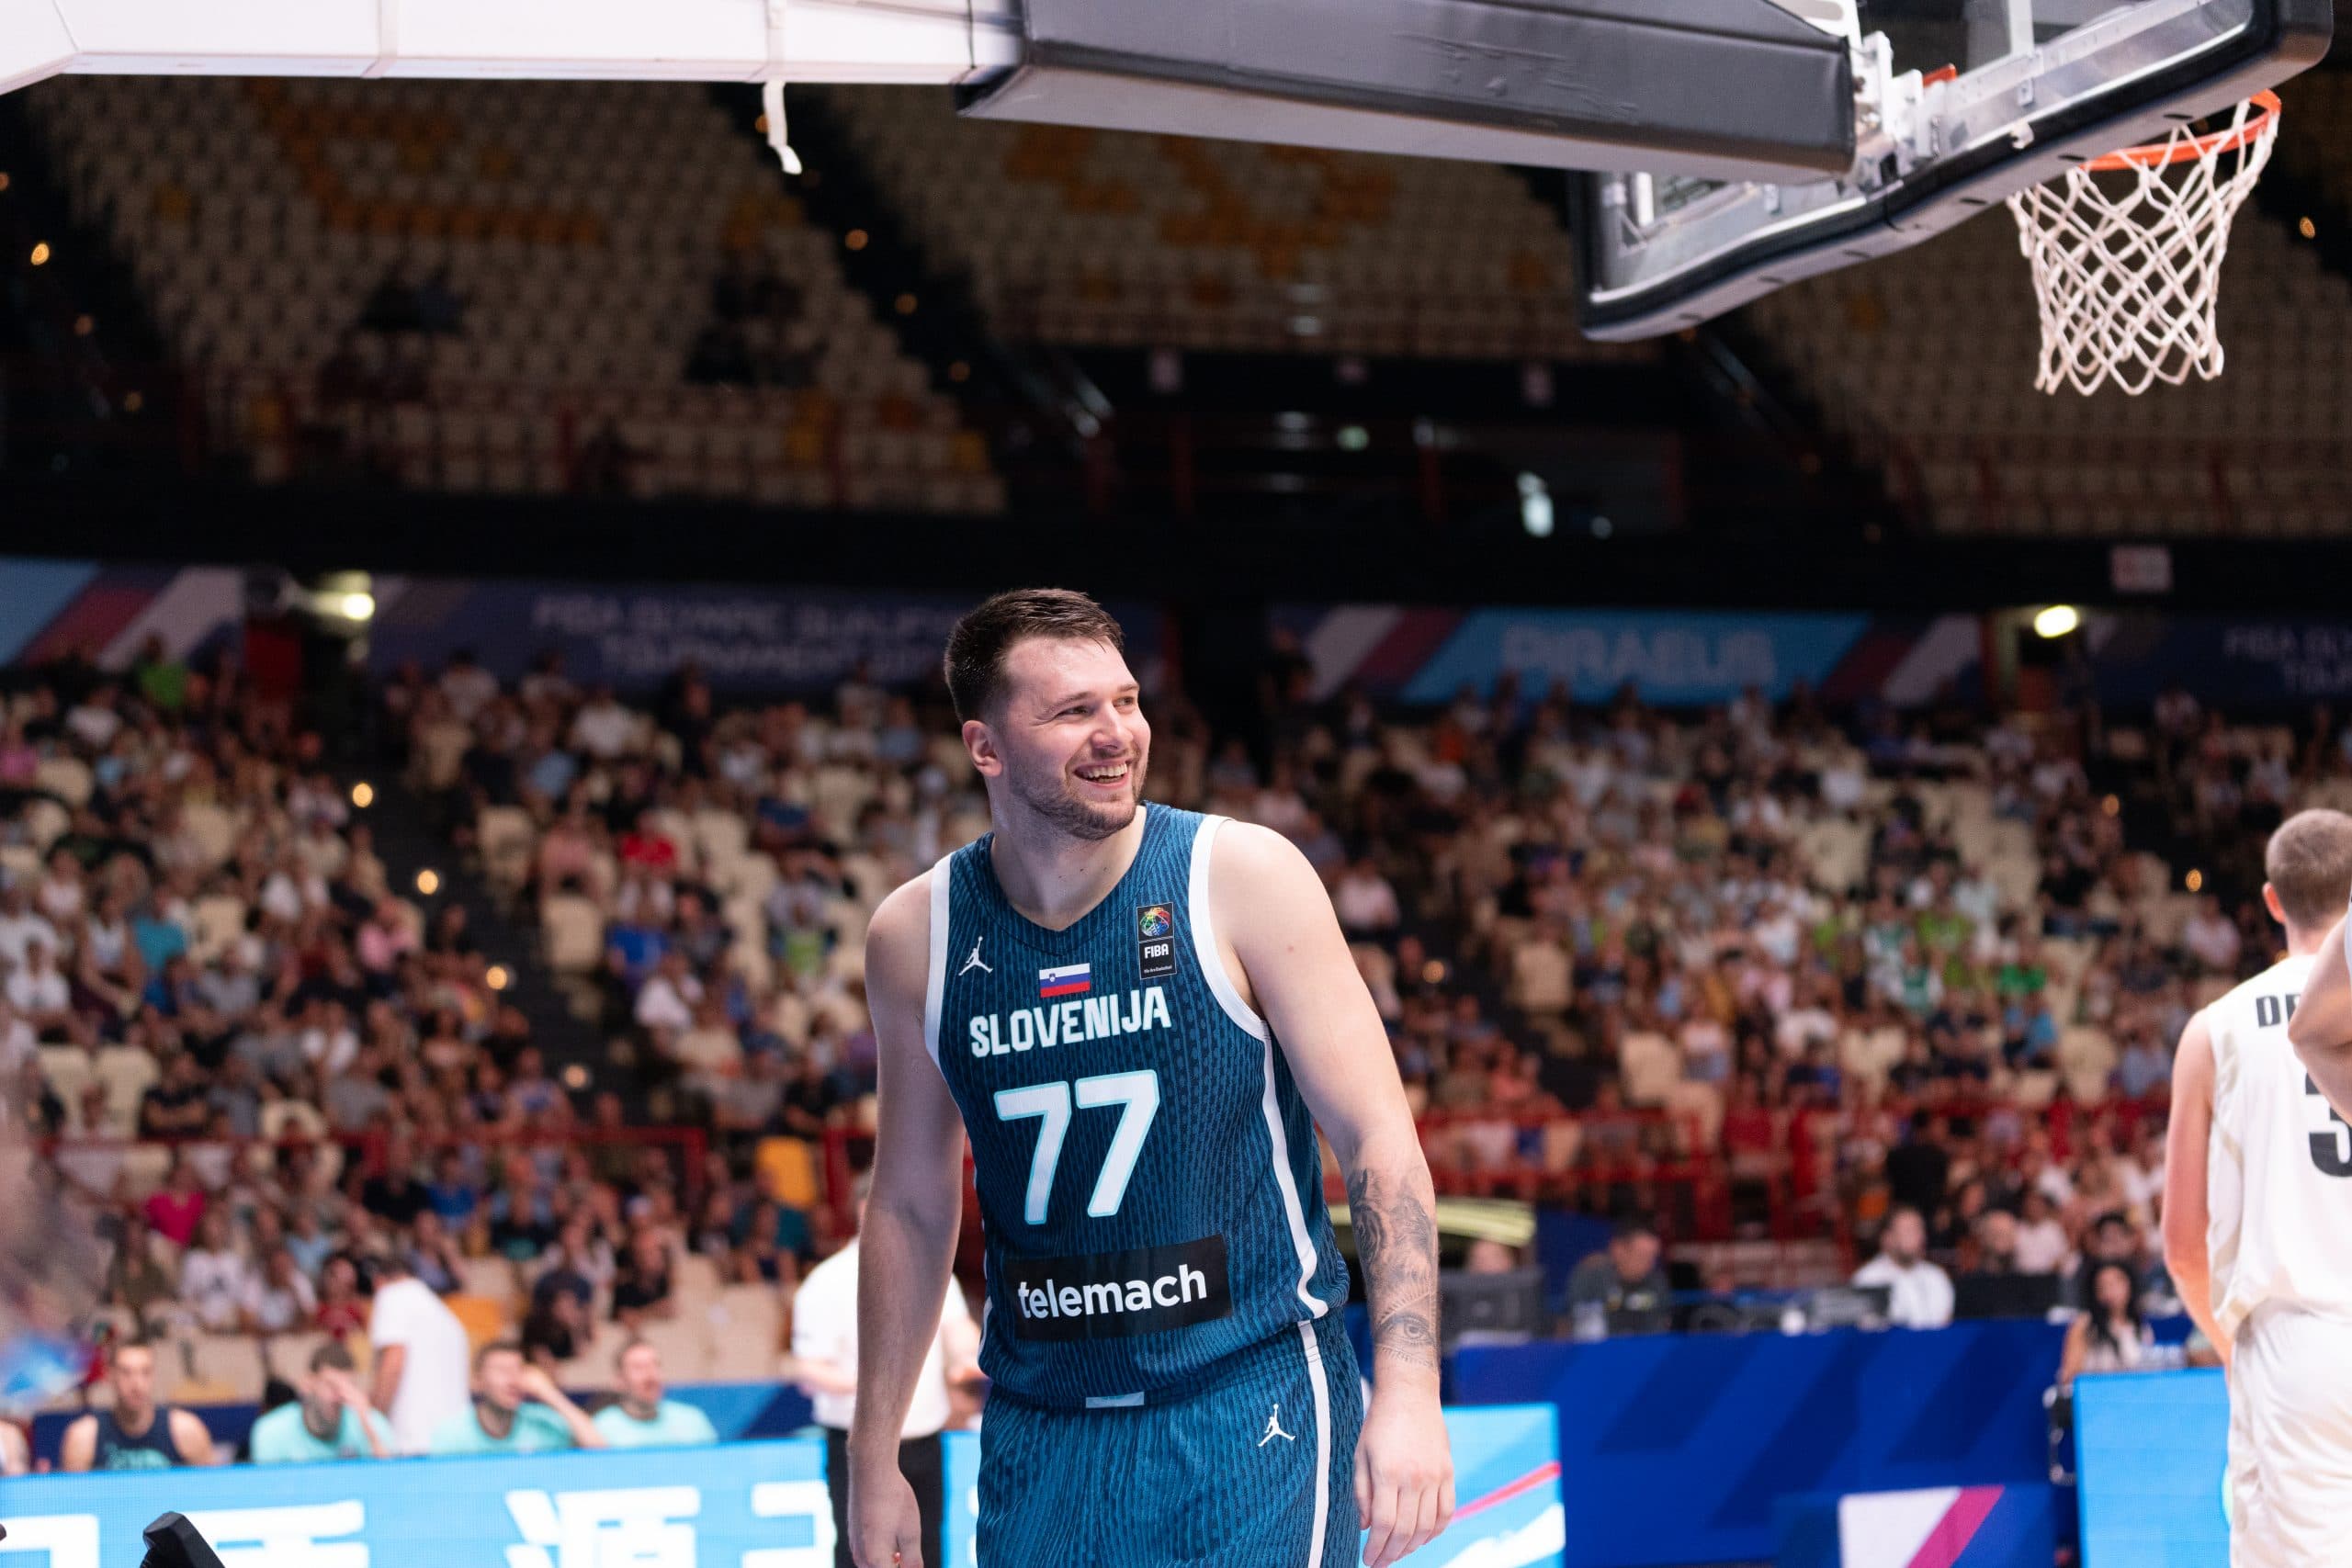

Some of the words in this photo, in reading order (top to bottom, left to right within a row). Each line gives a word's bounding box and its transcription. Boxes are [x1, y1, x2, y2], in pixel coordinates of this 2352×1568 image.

[1144, 943, 1169, 959] FIBA
[970, 986, 1171, 1057] SLOVENIJA
[994, 1069, 1160, 1225] 77
[1017, 1264, 1207, 1319] telemach
